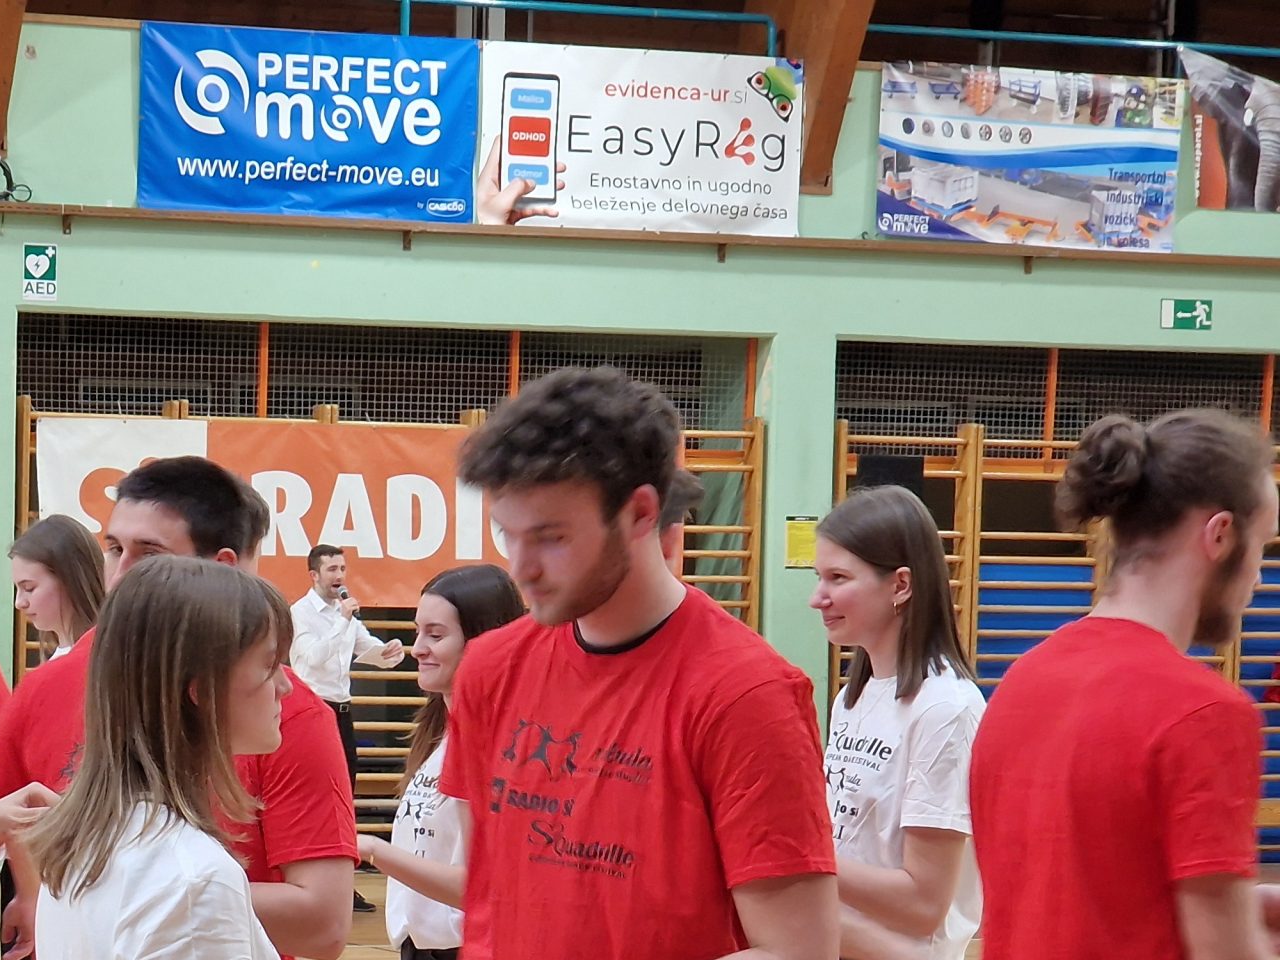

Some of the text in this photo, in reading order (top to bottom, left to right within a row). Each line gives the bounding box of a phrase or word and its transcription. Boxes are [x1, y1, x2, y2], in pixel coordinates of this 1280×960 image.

[257, 52, 447, 96] PERFECT
[605, 79, 748, 105] evidenca-ur.si
[255, 91, 442, 146] move
[512, 131, 546, 142] ODHOD
[177, 156, 440, 187] www.perfect-move.eu
[590, 172, 772, 196] Enostavno in ugodno
[1108, 167, 1167, 185] Transportni
[570, 195, 788, 220] beleženje delovnega časa
[893, 213, 930, 224] PERFECT
[23, 281, 57, 295] AED
[251, 469, 507, 560] RADI
